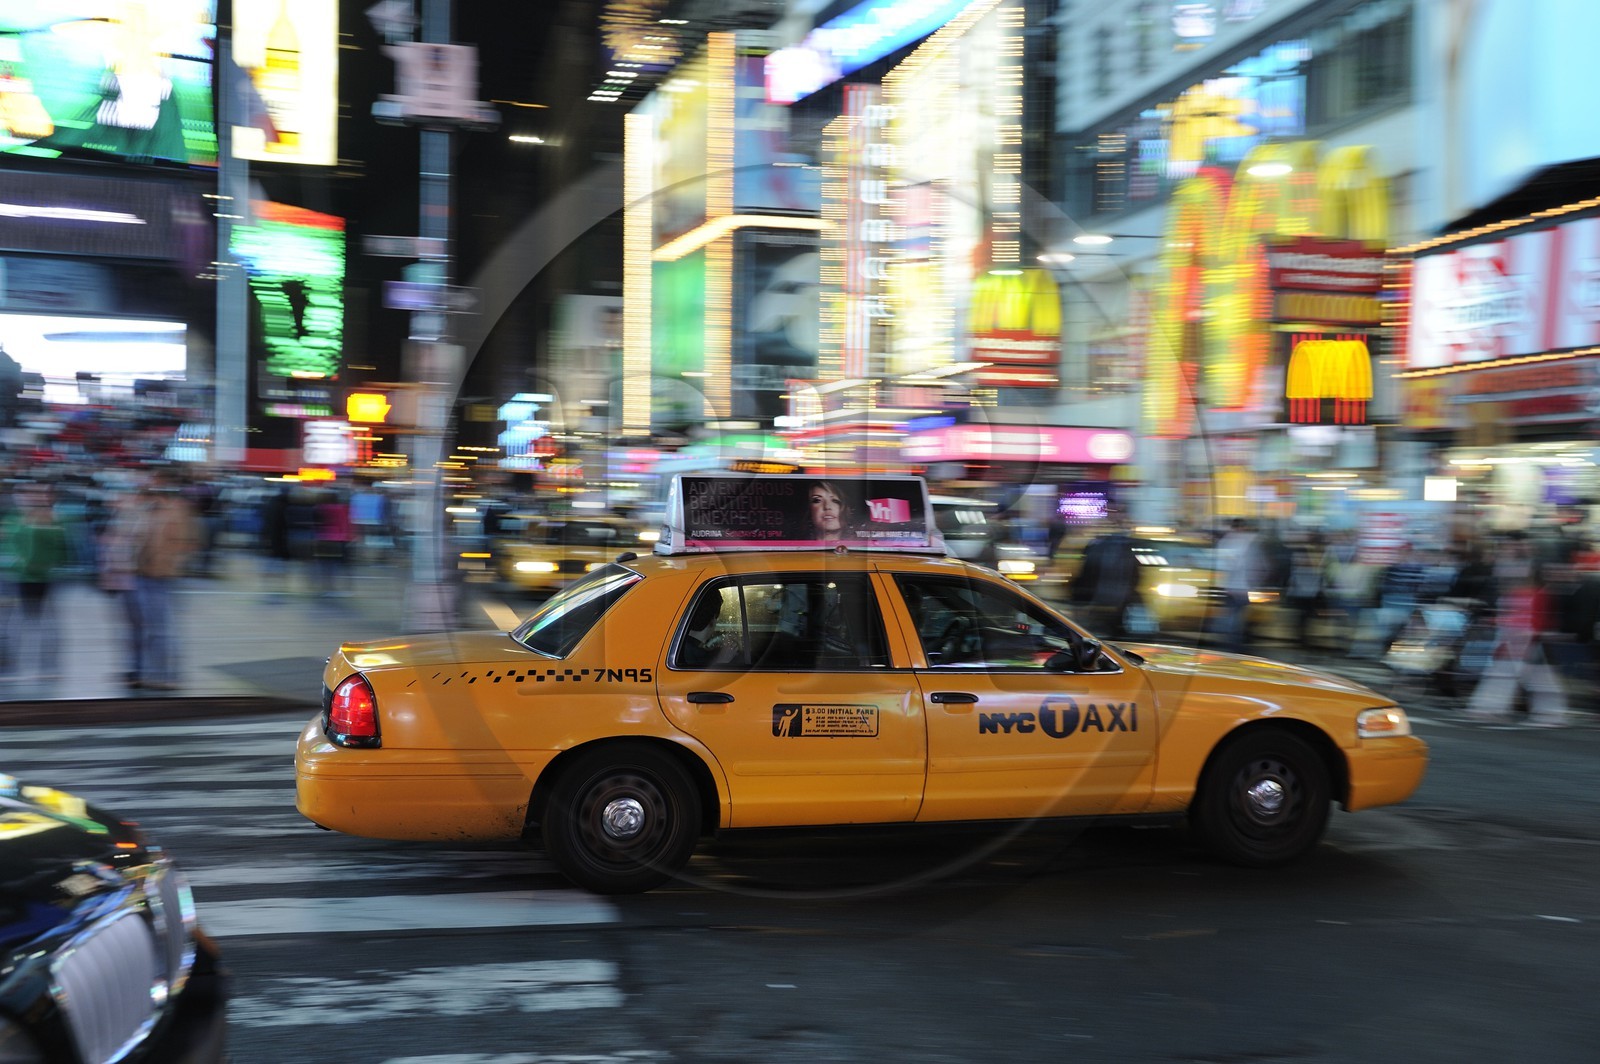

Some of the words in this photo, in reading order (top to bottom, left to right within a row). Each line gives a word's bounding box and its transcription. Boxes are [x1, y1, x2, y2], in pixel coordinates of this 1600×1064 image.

[689, 481, 794, 496] ADVENTUROUS
[689, 496, 768, 510] BEAUTIFUL
[691, 510, 784, 525] UNEXPECTED
[691, 530, 722, 538] AUDRINA
[594, 669, 653, 683] 7N95
[979, 713, 1036, 734] NYC
[1043, 700, 1139, 734] TAXI
